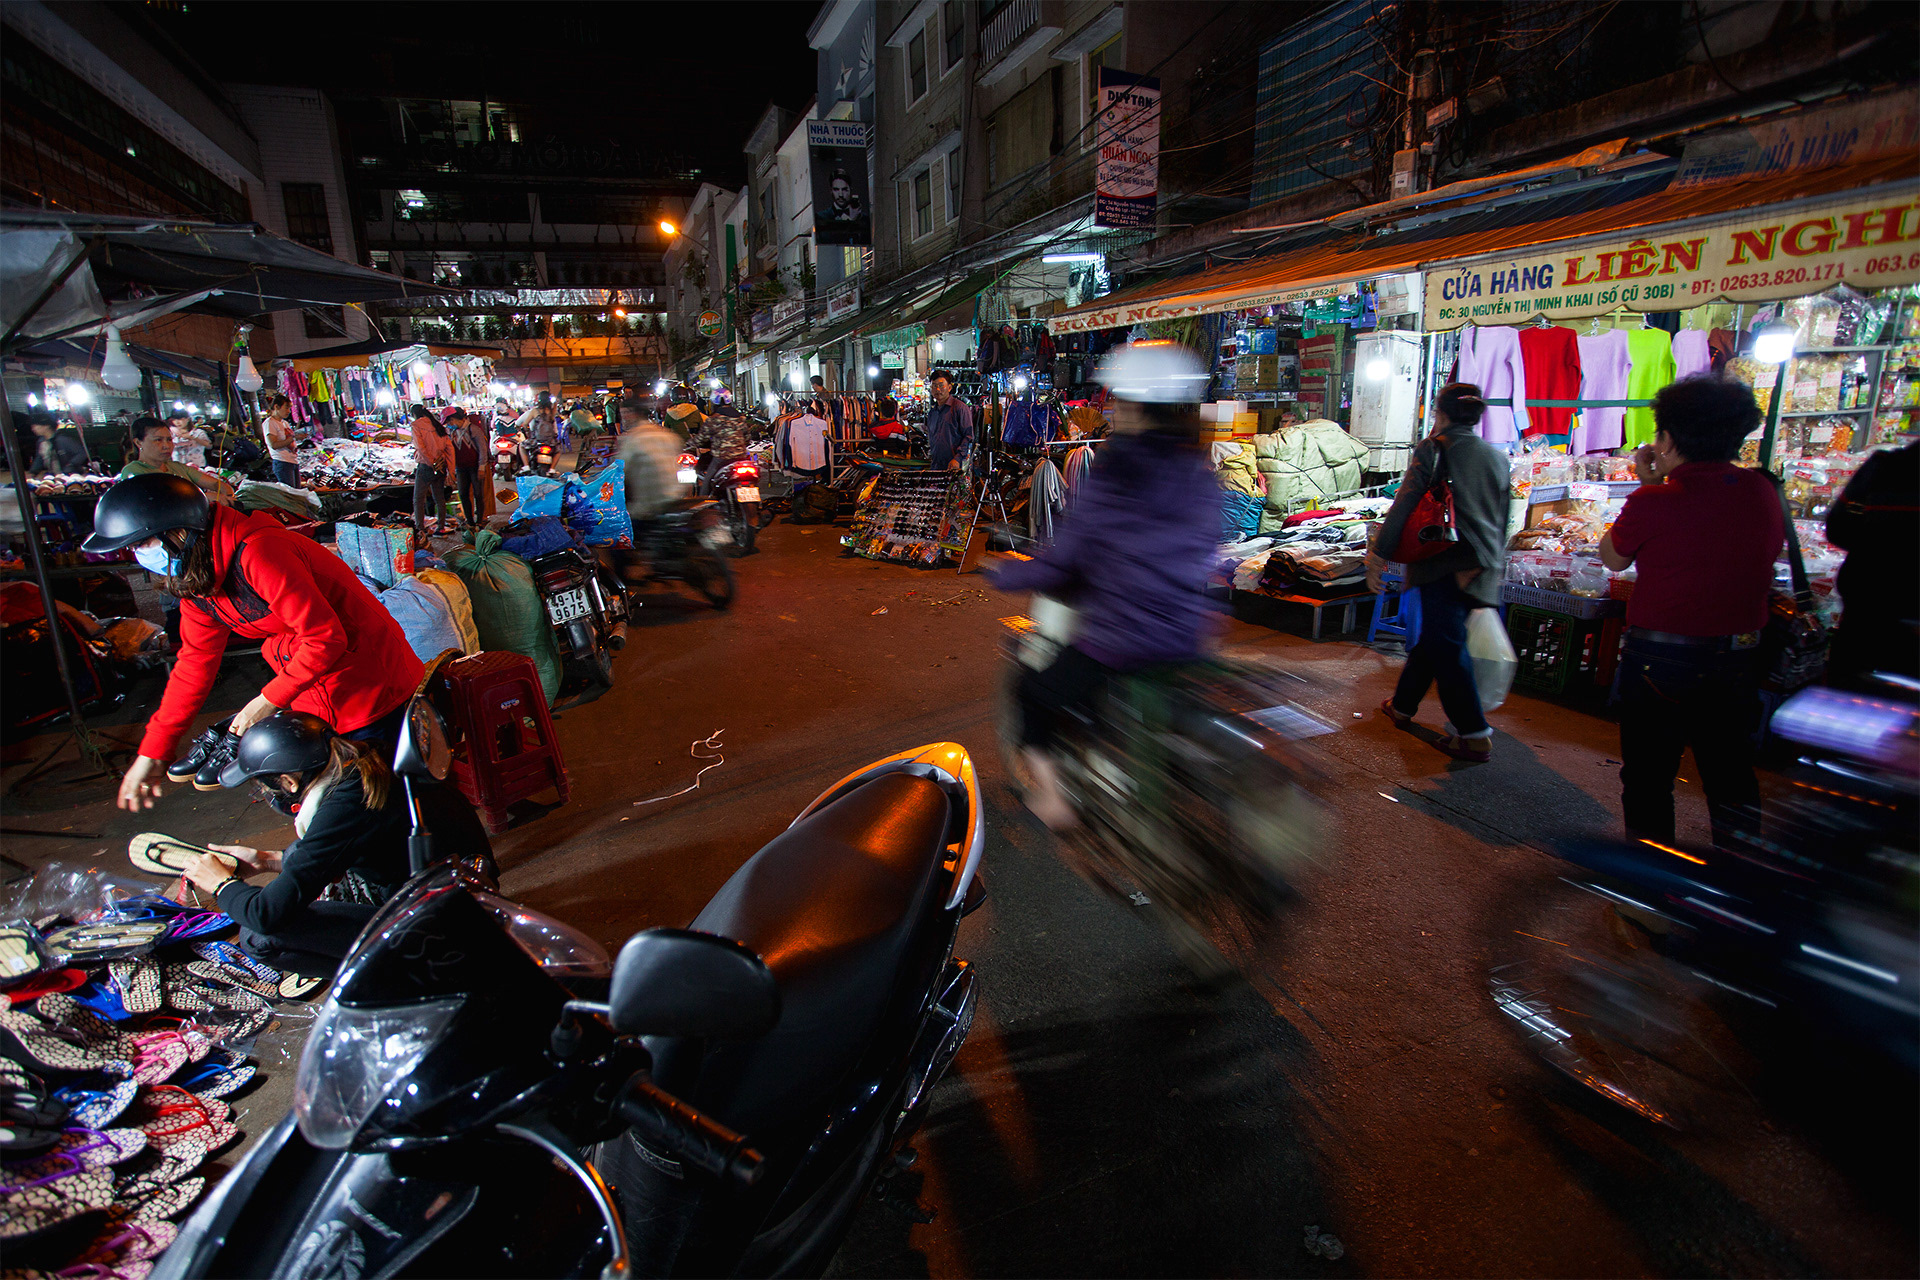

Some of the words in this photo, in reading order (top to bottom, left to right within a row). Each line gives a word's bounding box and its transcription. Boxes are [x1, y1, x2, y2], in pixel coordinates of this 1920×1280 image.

[811, 123, 829, 135] NHÀ
[832, 124, 864, 136] THUỐC
[811, 136, 834, 144] TOÀN
[836, 138, 865, 146] KHANG
[1102, 144, 1126, 162] HUẤN
[1442, 267, 1481, 301] CỬA
[1490, 262, 1554, 295] HÀNG
[1562, 237, 1709, 287] LIÊN
[1727, 194, 1920, 266] NGH
[1440, 308, 1455, 320] ĐC:
[1458, 306, 1469, 318] 30
[1471, 297, 1511, 316] NGUYỄN
[1513, 301, 1530, 315] THỊ
[1533, 296, 1561, 311] MINH
[1565, 292, 1593, 309] KHAI
[1597, 285, 1618, 306] (SỐ
[1621, 284, 1639, 303] CŨ
[1643, 283, 1675, 301] 30B)
[1691, 279, 1715, 296] ĐT:
[1720, 262, 1844, 292] 02633.820.171
[1054, 311, 1119, 332] HUẤN
[1400, 363, 1412, 376] 14
[555, 601, 585, 620] 9675
